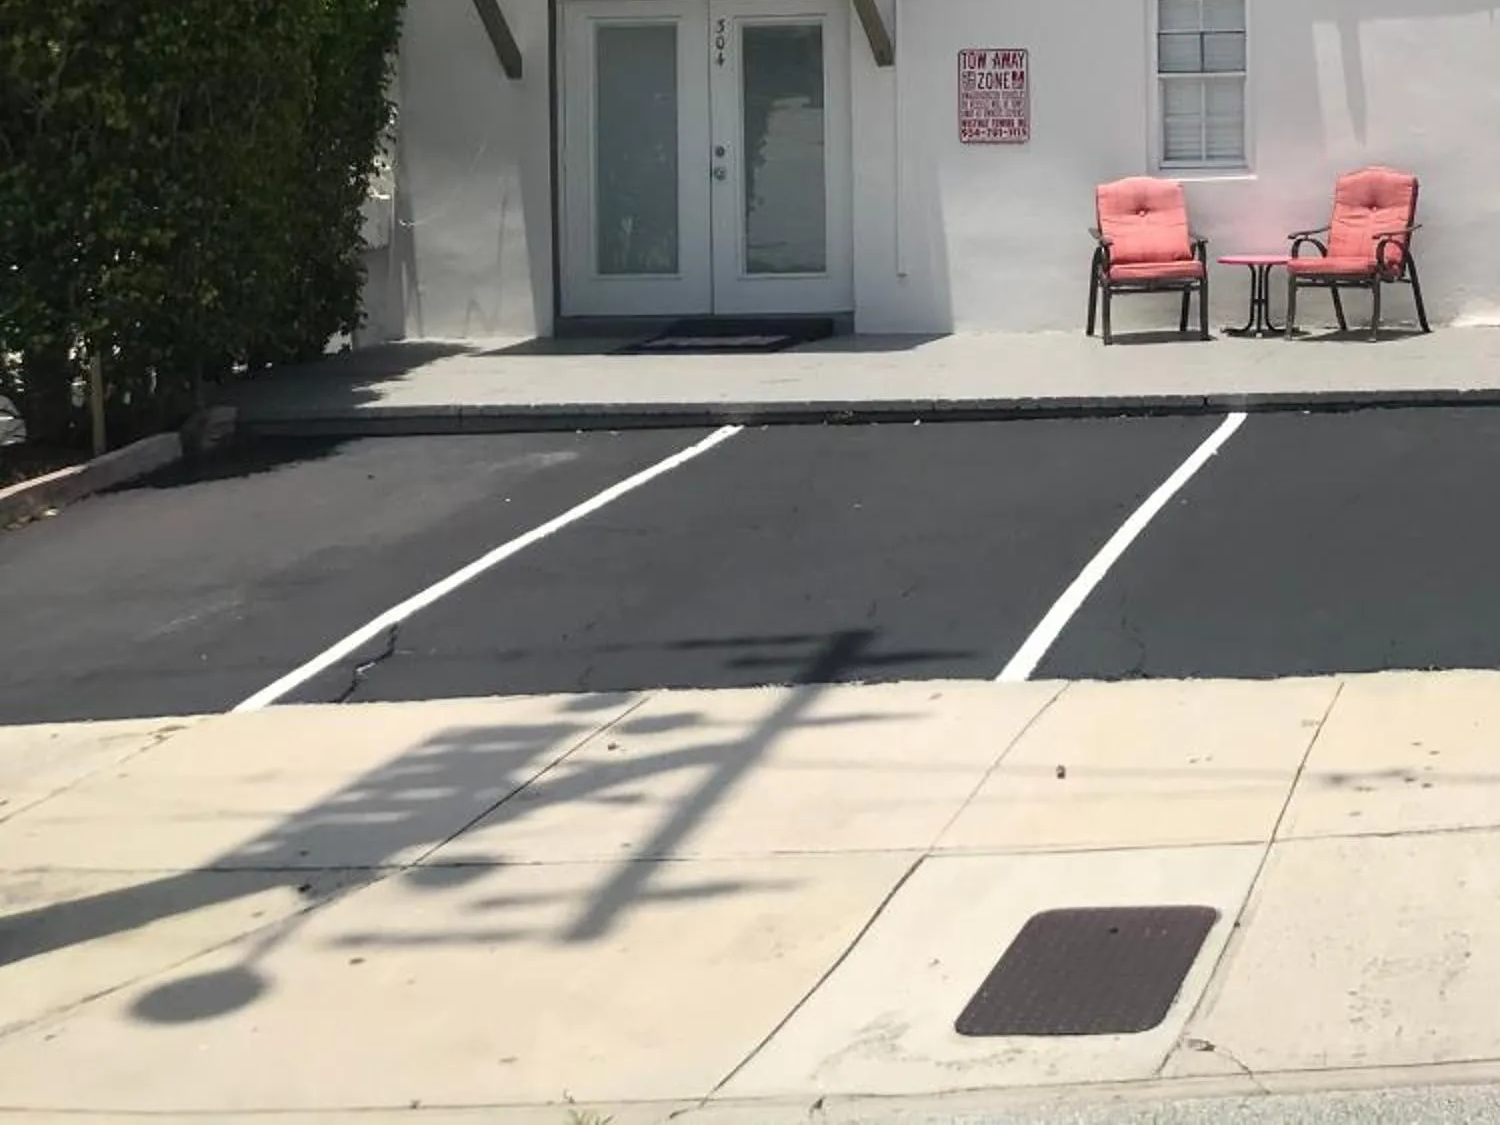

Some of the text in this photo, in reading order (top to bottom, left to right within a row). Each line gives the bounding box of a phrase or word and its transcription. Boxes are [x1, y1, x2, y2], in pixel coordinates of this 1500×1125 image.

[715, 18, 725, 67] 304
[962, 52, 1025, 70] TOW AWAY
[977, 72, 1010, 90] ZONE
